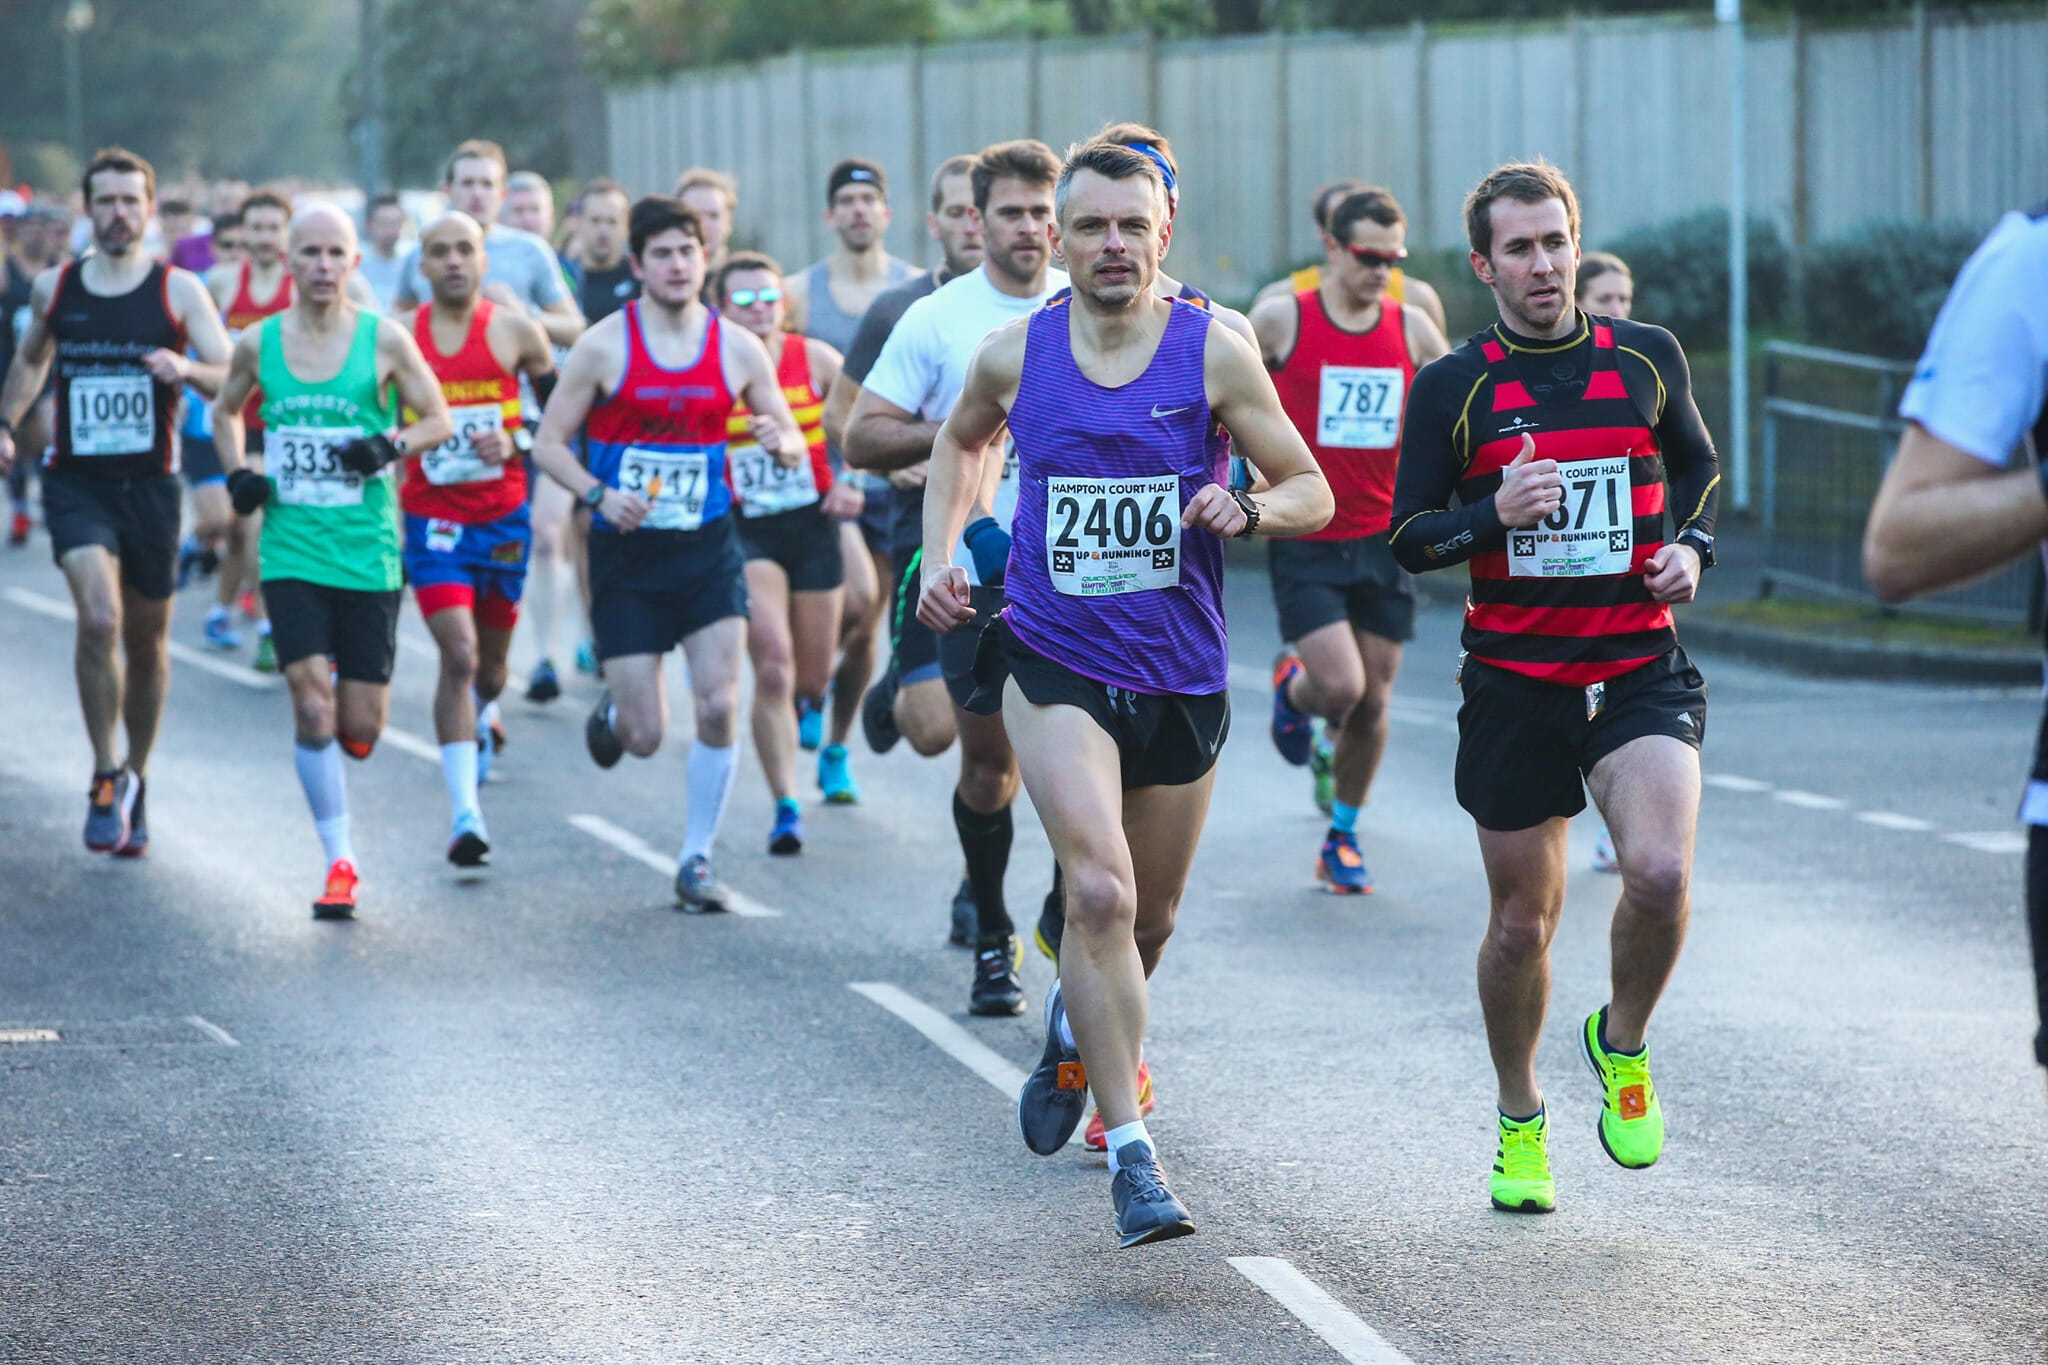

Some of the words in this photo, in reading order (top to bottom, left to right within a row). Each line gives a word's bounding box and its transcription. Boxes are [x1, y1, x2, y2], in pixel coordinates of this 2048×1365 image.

[80, 392, 148, 421] 1000
[1338, 382, 1388, 413] 787
[282, 441, 337, 473] 333
[1566, 466, 1599, 479] COURT
[1601, 463, 1626, 475] HALF
[1052, 483, 1105, 495] HAMPTON
[1108, 484, 1146, 495] COURT
[1148, 481, 1175, 493] HALF
[1517, 478, 1619, 532] 871
[1055, 495, 1172, 548] 2406
[1537, 533, 1550, 543] UP
[1561, 530, 1607, 543] RUNNING
[1076, 551, 1090, 560] UP
[1102, 549, 1151, 560] RUNNING
